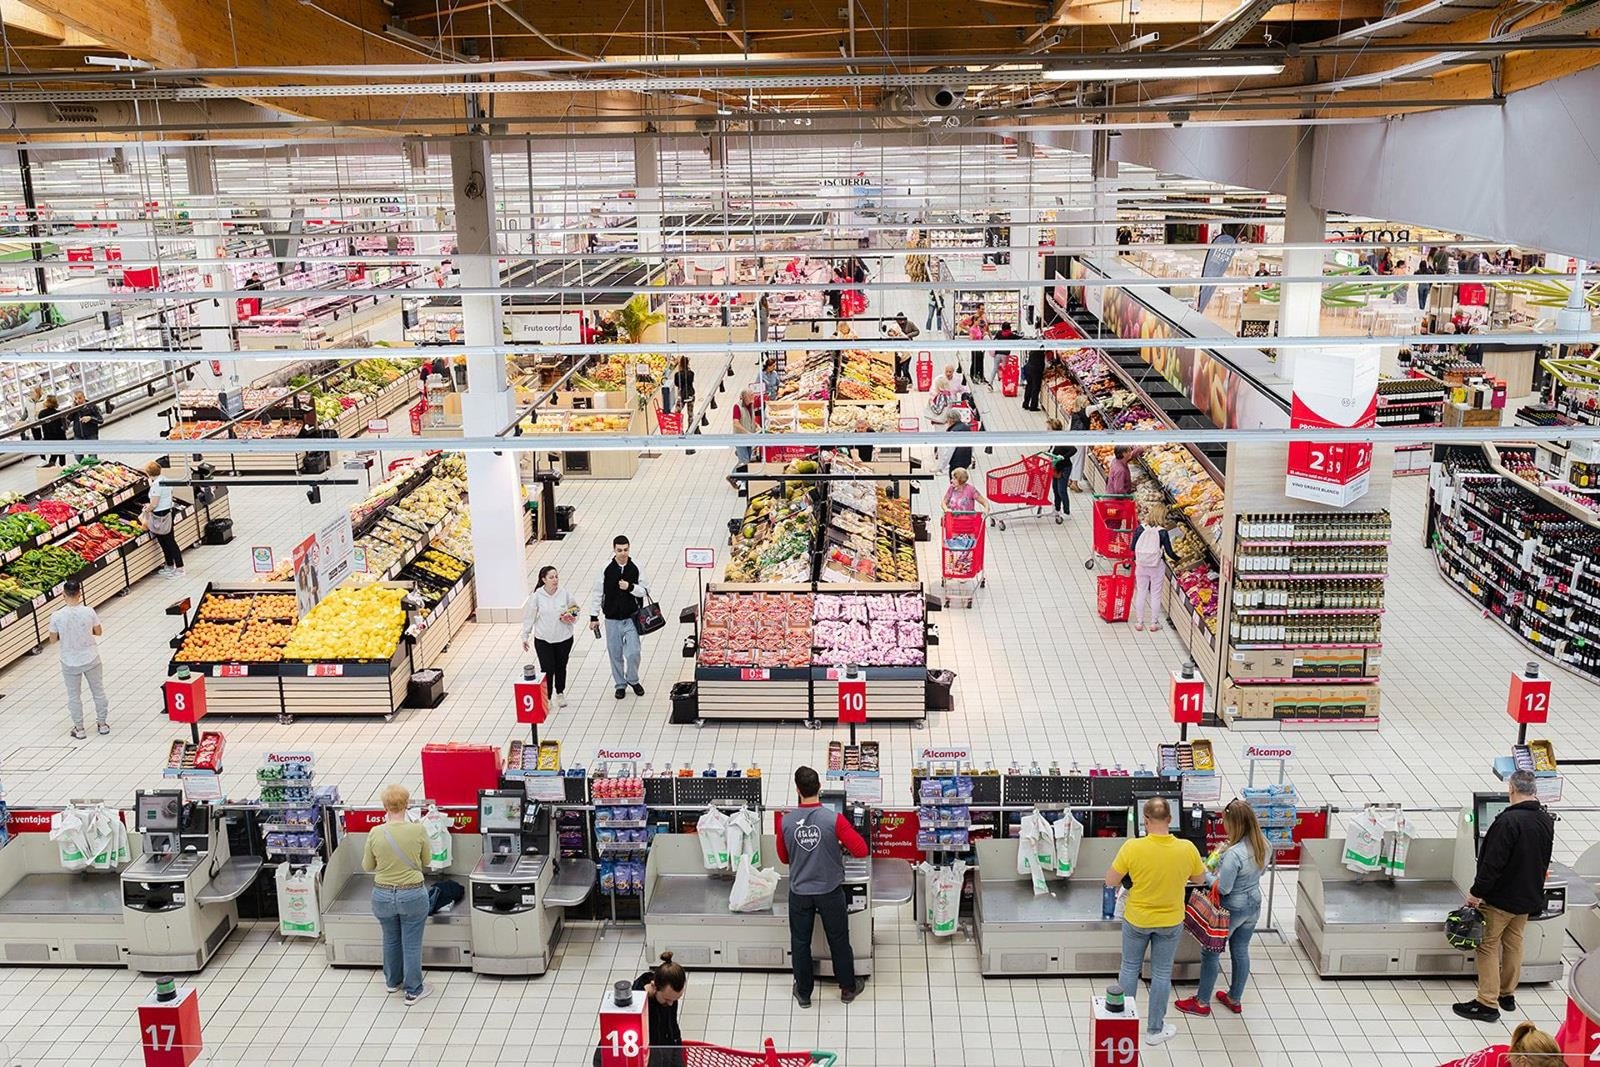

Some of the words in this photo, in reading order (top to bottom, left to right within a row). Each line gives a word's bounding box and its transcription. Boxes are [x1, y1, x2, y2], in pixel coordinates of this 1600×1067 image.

[523, 324, 543, 332] Fruta
[544, 324, 573, 332] cortada
[175, 693, 186, 711] 8
[523, 694, 534, 712] 9
[842, 692, 864, 711] 10
[1179, 693, 1200, 712] 11
[1524, 693, 1547, 711] 12
[267, 753, 311, 763] Alcampo
[597, 749, 642, 759] Alcampo
[922, 749, 967, 759] Alcampo
[1246, 746, 1292, 757] Alcampo
[15, 815, 50, 825] ventajas
[884, 840, 913, 848] disponible
[145, 1024, 177, 1052] 17
[605, 1029, 640, 1058] 18
[1100, 1036, 1135, 1065] 19
